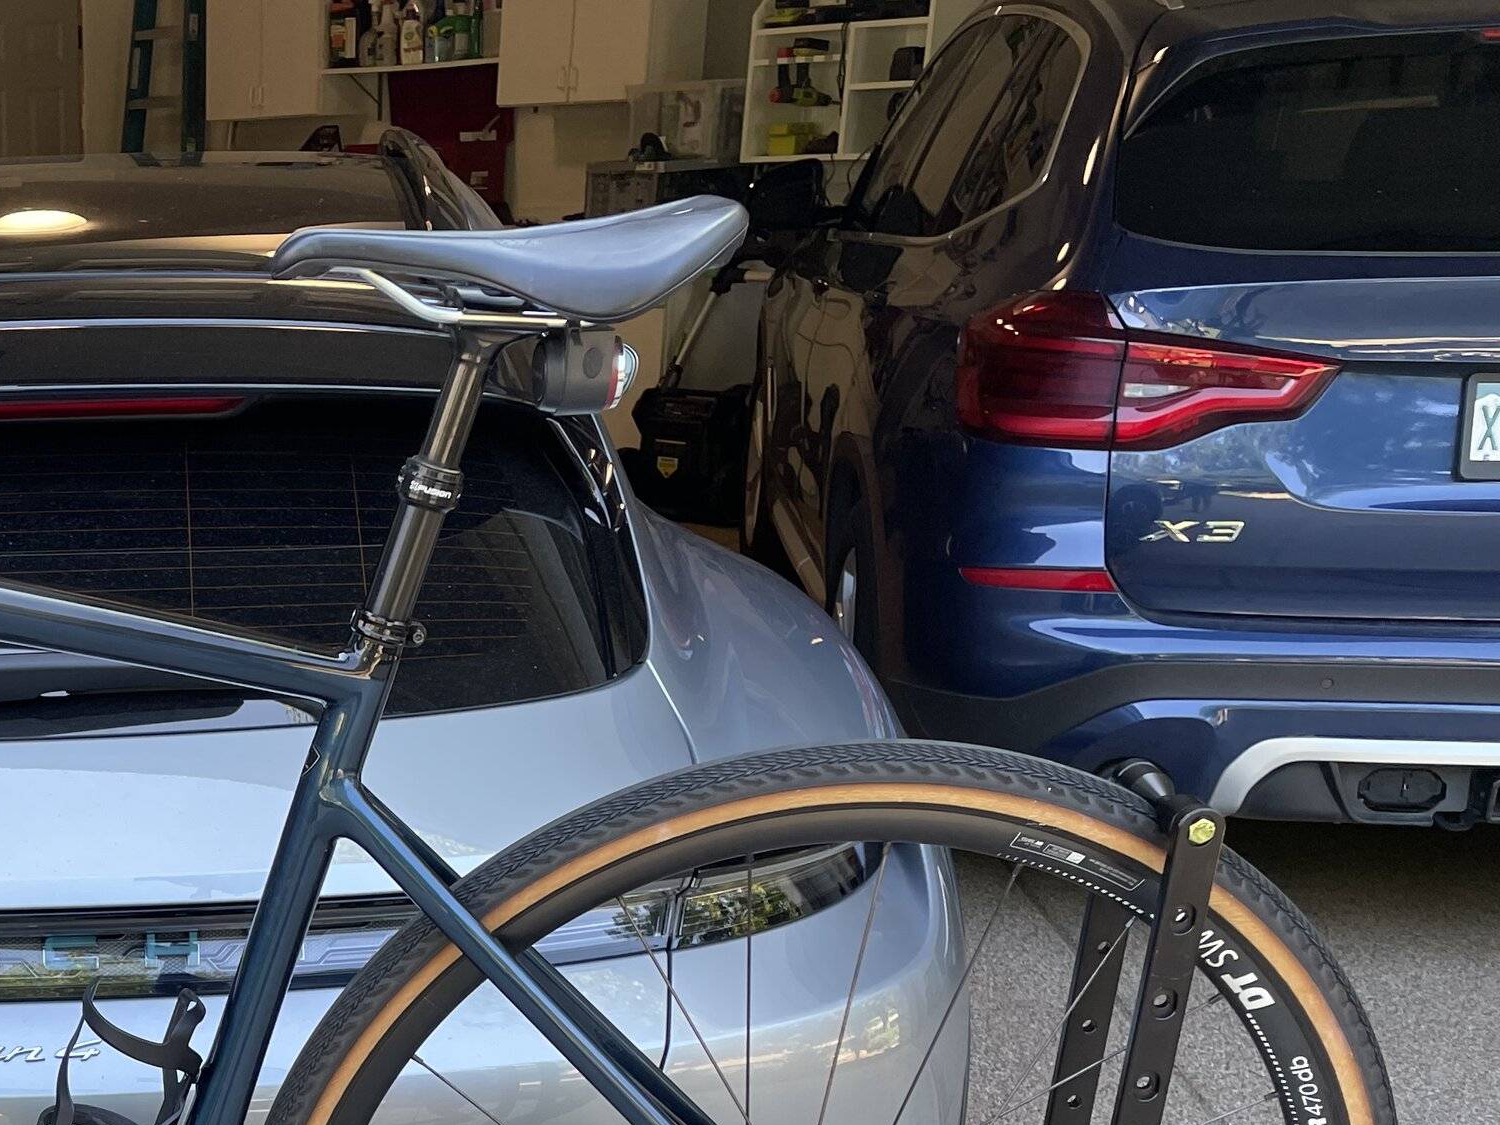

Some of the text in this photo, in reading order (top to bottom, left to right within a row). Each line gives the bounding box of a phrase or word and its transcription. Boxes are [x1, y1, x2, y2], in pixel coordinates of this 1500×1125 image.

[1139, 520, 1246, 543] X3
[1220, 972, 1276, 1011] DT
[54, 1039, 102, 1062] 4
